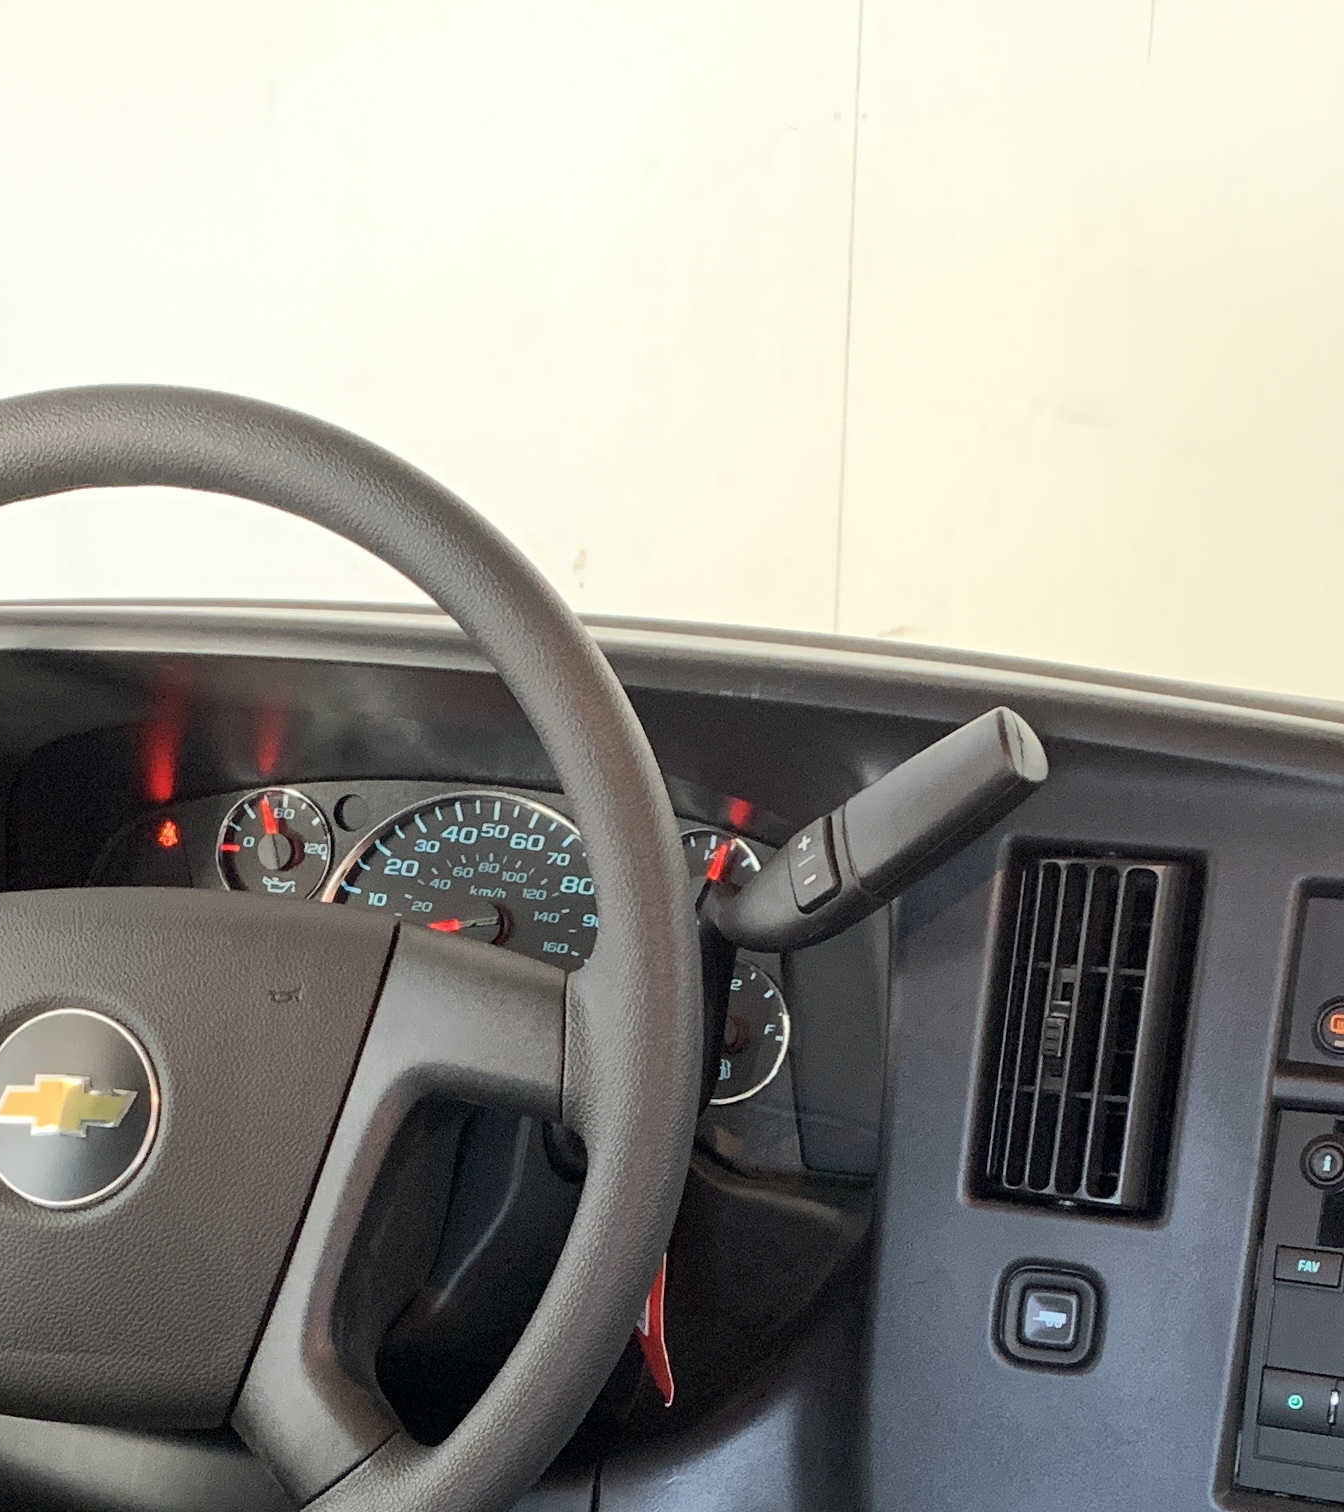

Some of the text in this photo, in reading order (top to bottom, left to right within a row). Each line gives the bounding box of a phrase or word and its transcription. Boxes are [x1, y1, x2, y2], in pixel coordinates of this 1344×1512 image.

[273, 808, 296, 820] 60
[441, 825, 478, 844] 40
[480, 823, 509, 839] 50
[243, 836, 255, 848] 0
[414, 839, 440, 854] 30
[510, 832, 545, 851] 60
[304, 842, 328, 855] 120
[546, 852, 571, 866] 70
[384, 858, 419, 877] 20
[452, 866, 474, 878] 60
[478, 862, 500, 874] 80
[501, 871, 527, 883] 100
[429, 878, 451, 890] 40
[560, 876, 595, 895] 80
[469, 885, 507, 898] km/h
[522, 888, 547, 900] 120
[368, 892, 387, 906] 10
[411, 901, 433, 913] 20
[533, 911, 560, 923] 140
[582, 913, 599, 928] 9
[542, 941, 569, 954] 160
[764, 1023, 776, 1035] F
[1297, 1259, 1321, 1273] FAV
